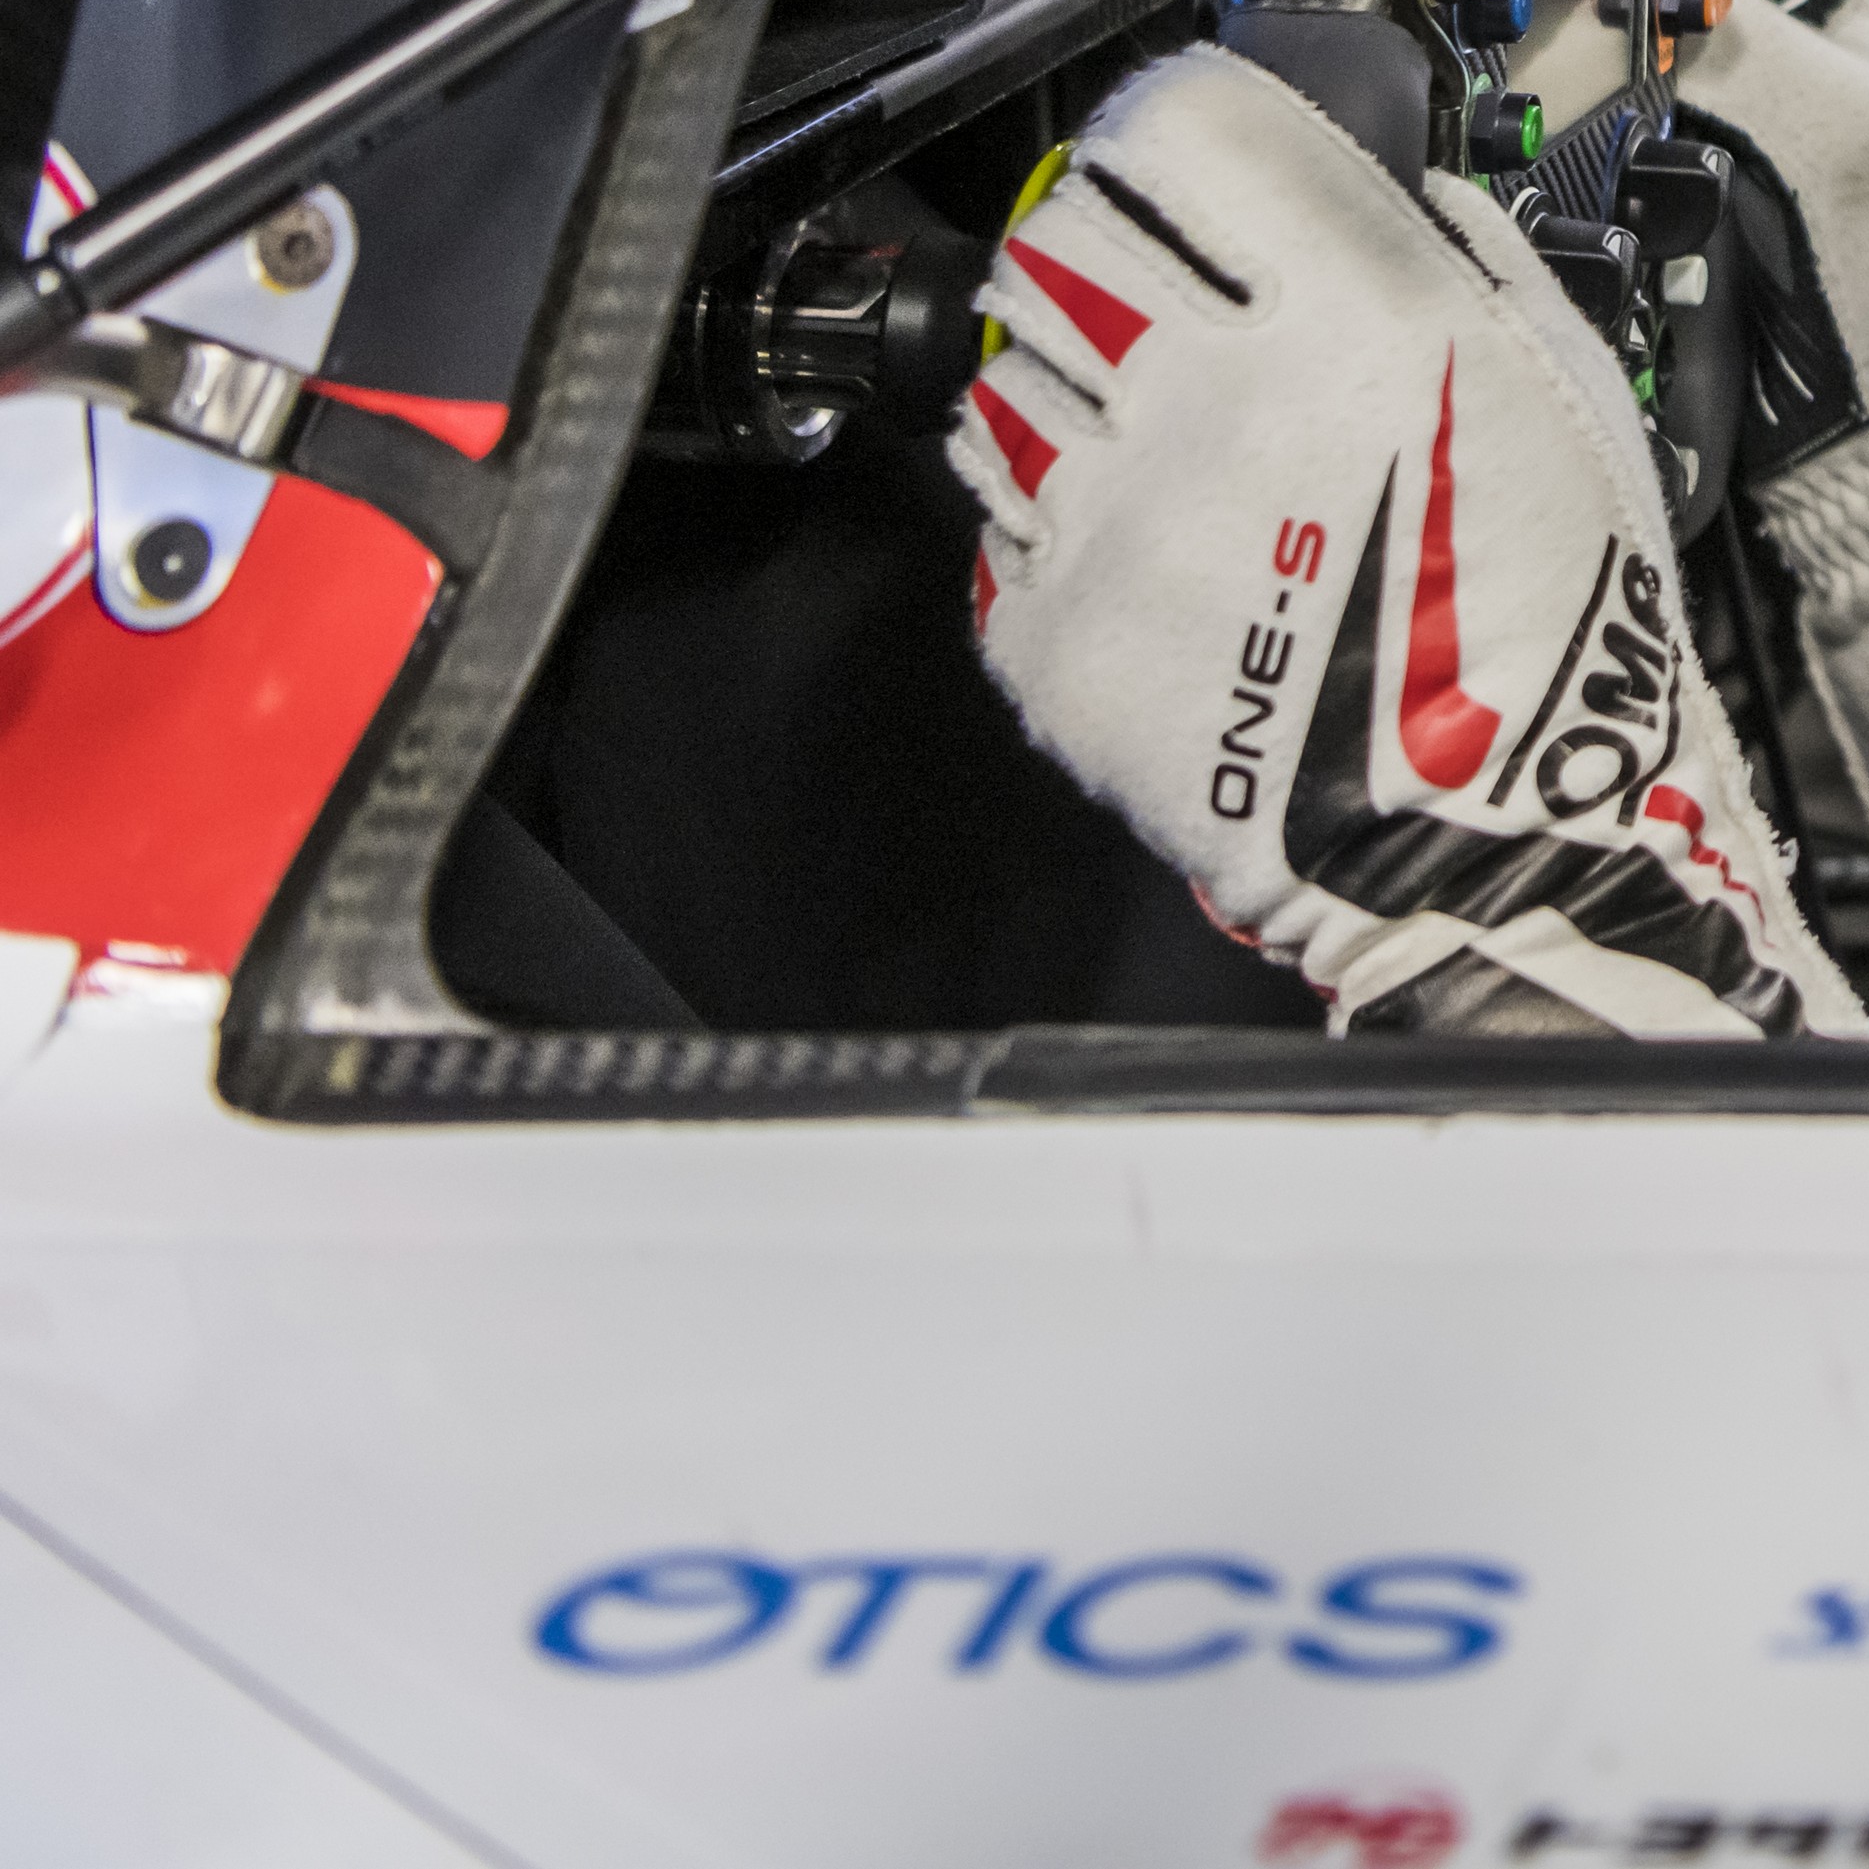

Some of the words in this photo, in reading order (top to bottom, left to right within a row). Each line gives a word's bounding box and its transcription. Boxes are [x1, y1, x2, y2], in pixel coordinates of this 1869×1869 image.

[1210, 516, 1328, 822] ONE-S
[1536, 552, 1671, 820] OMP
[533, 1546, 1525, 1681] OTICS
